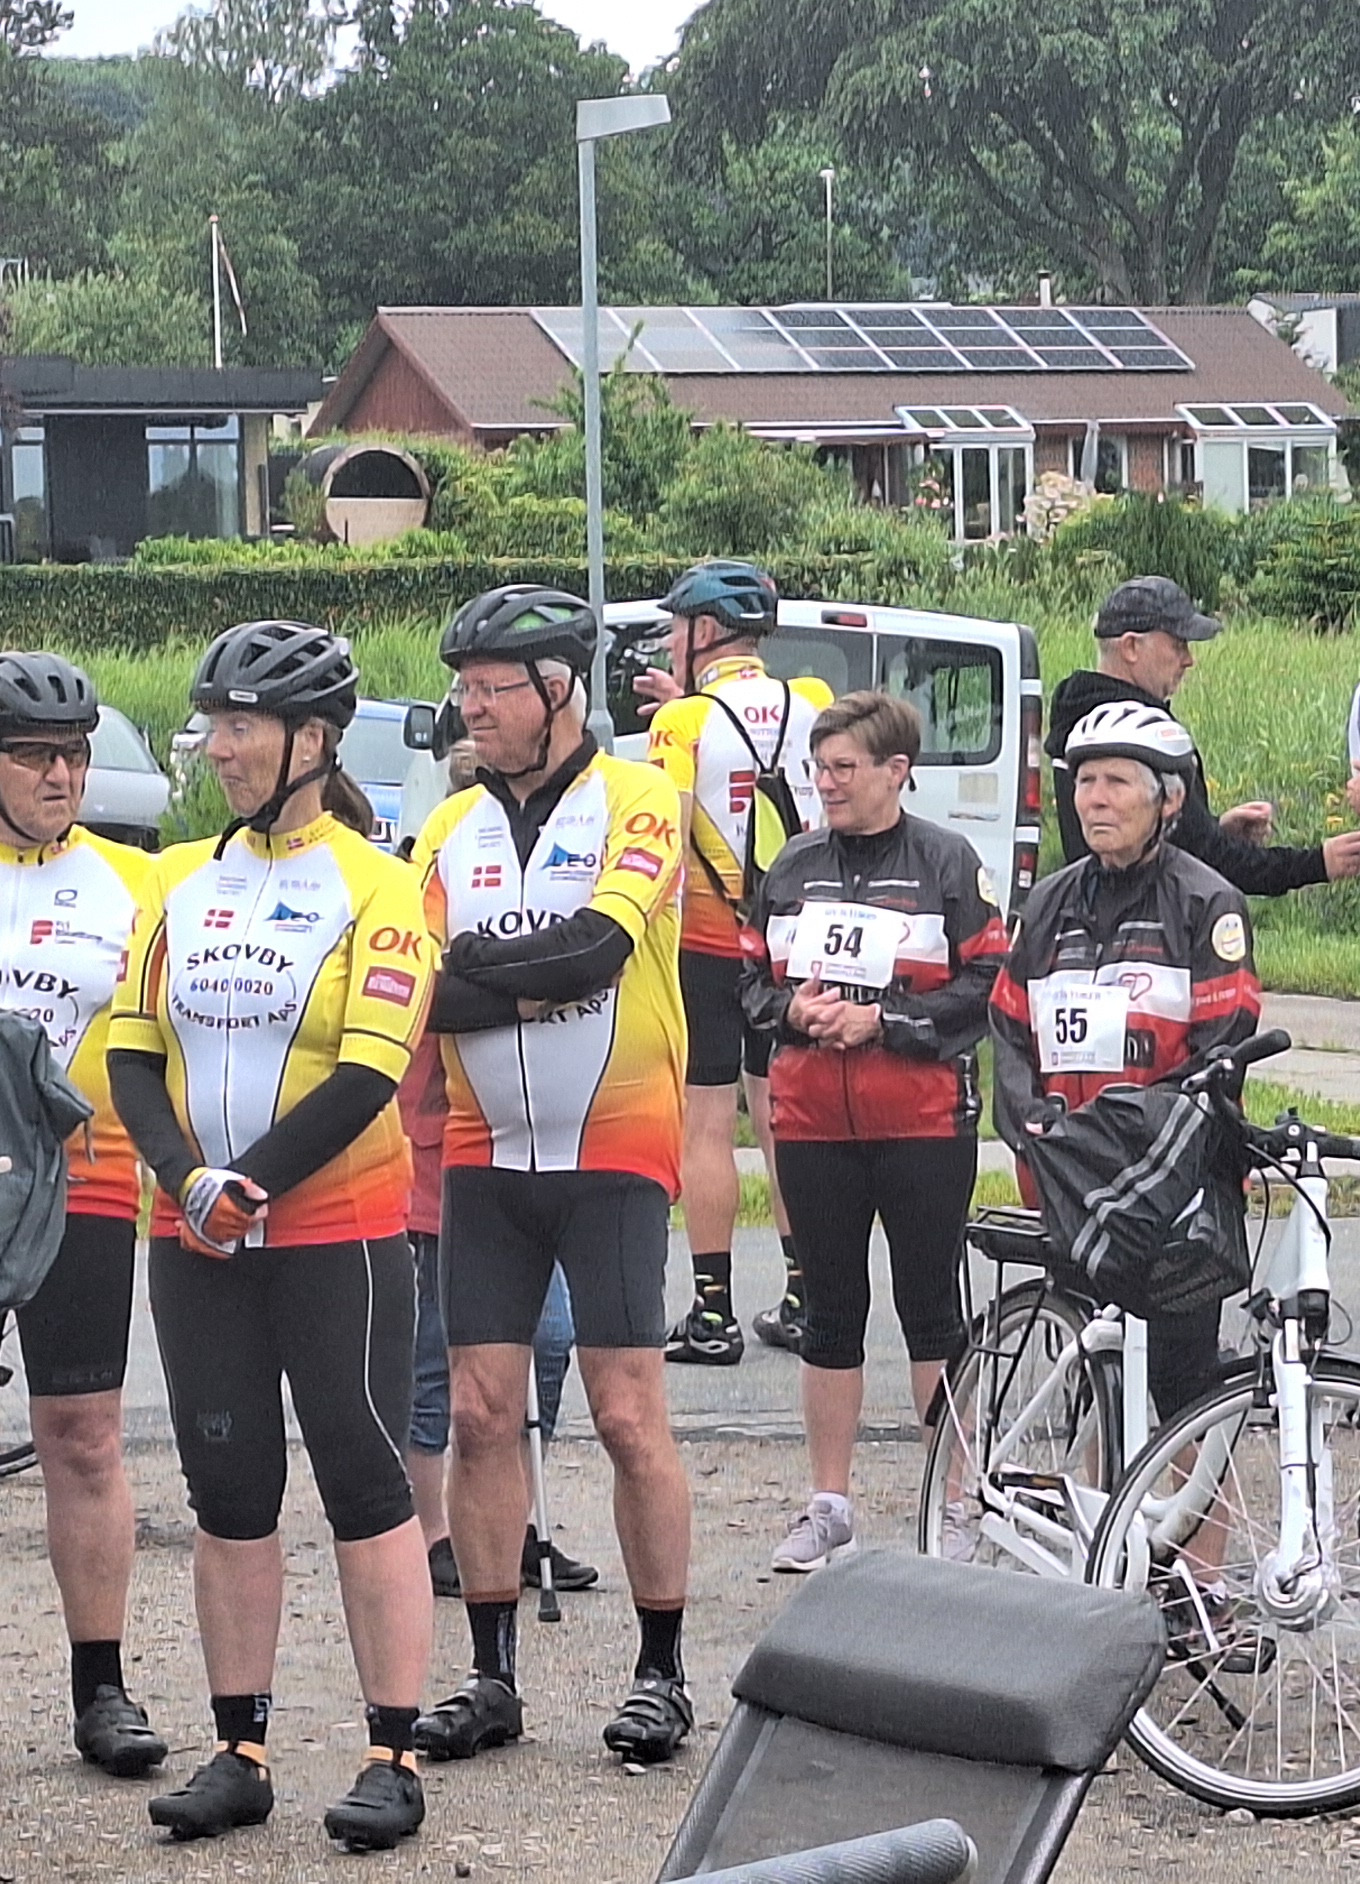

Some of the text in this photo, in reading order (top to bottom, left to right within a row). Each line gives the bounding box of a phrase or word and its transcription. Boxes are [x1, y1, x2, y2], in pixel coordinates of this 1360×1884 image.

[744, 704, 781, 724] OK
[625, 812, 677, 850] OK
[186, 943, 294, 973] SKOVBY
[369, 927, 423, 964] OK
[824, 923, 864, 958] 54
[189, 977, 273, 996] 6040 0020
[172, 994, 260, 1030] TRANSPORT
[1055, 1007, 1088, 1045] 55
